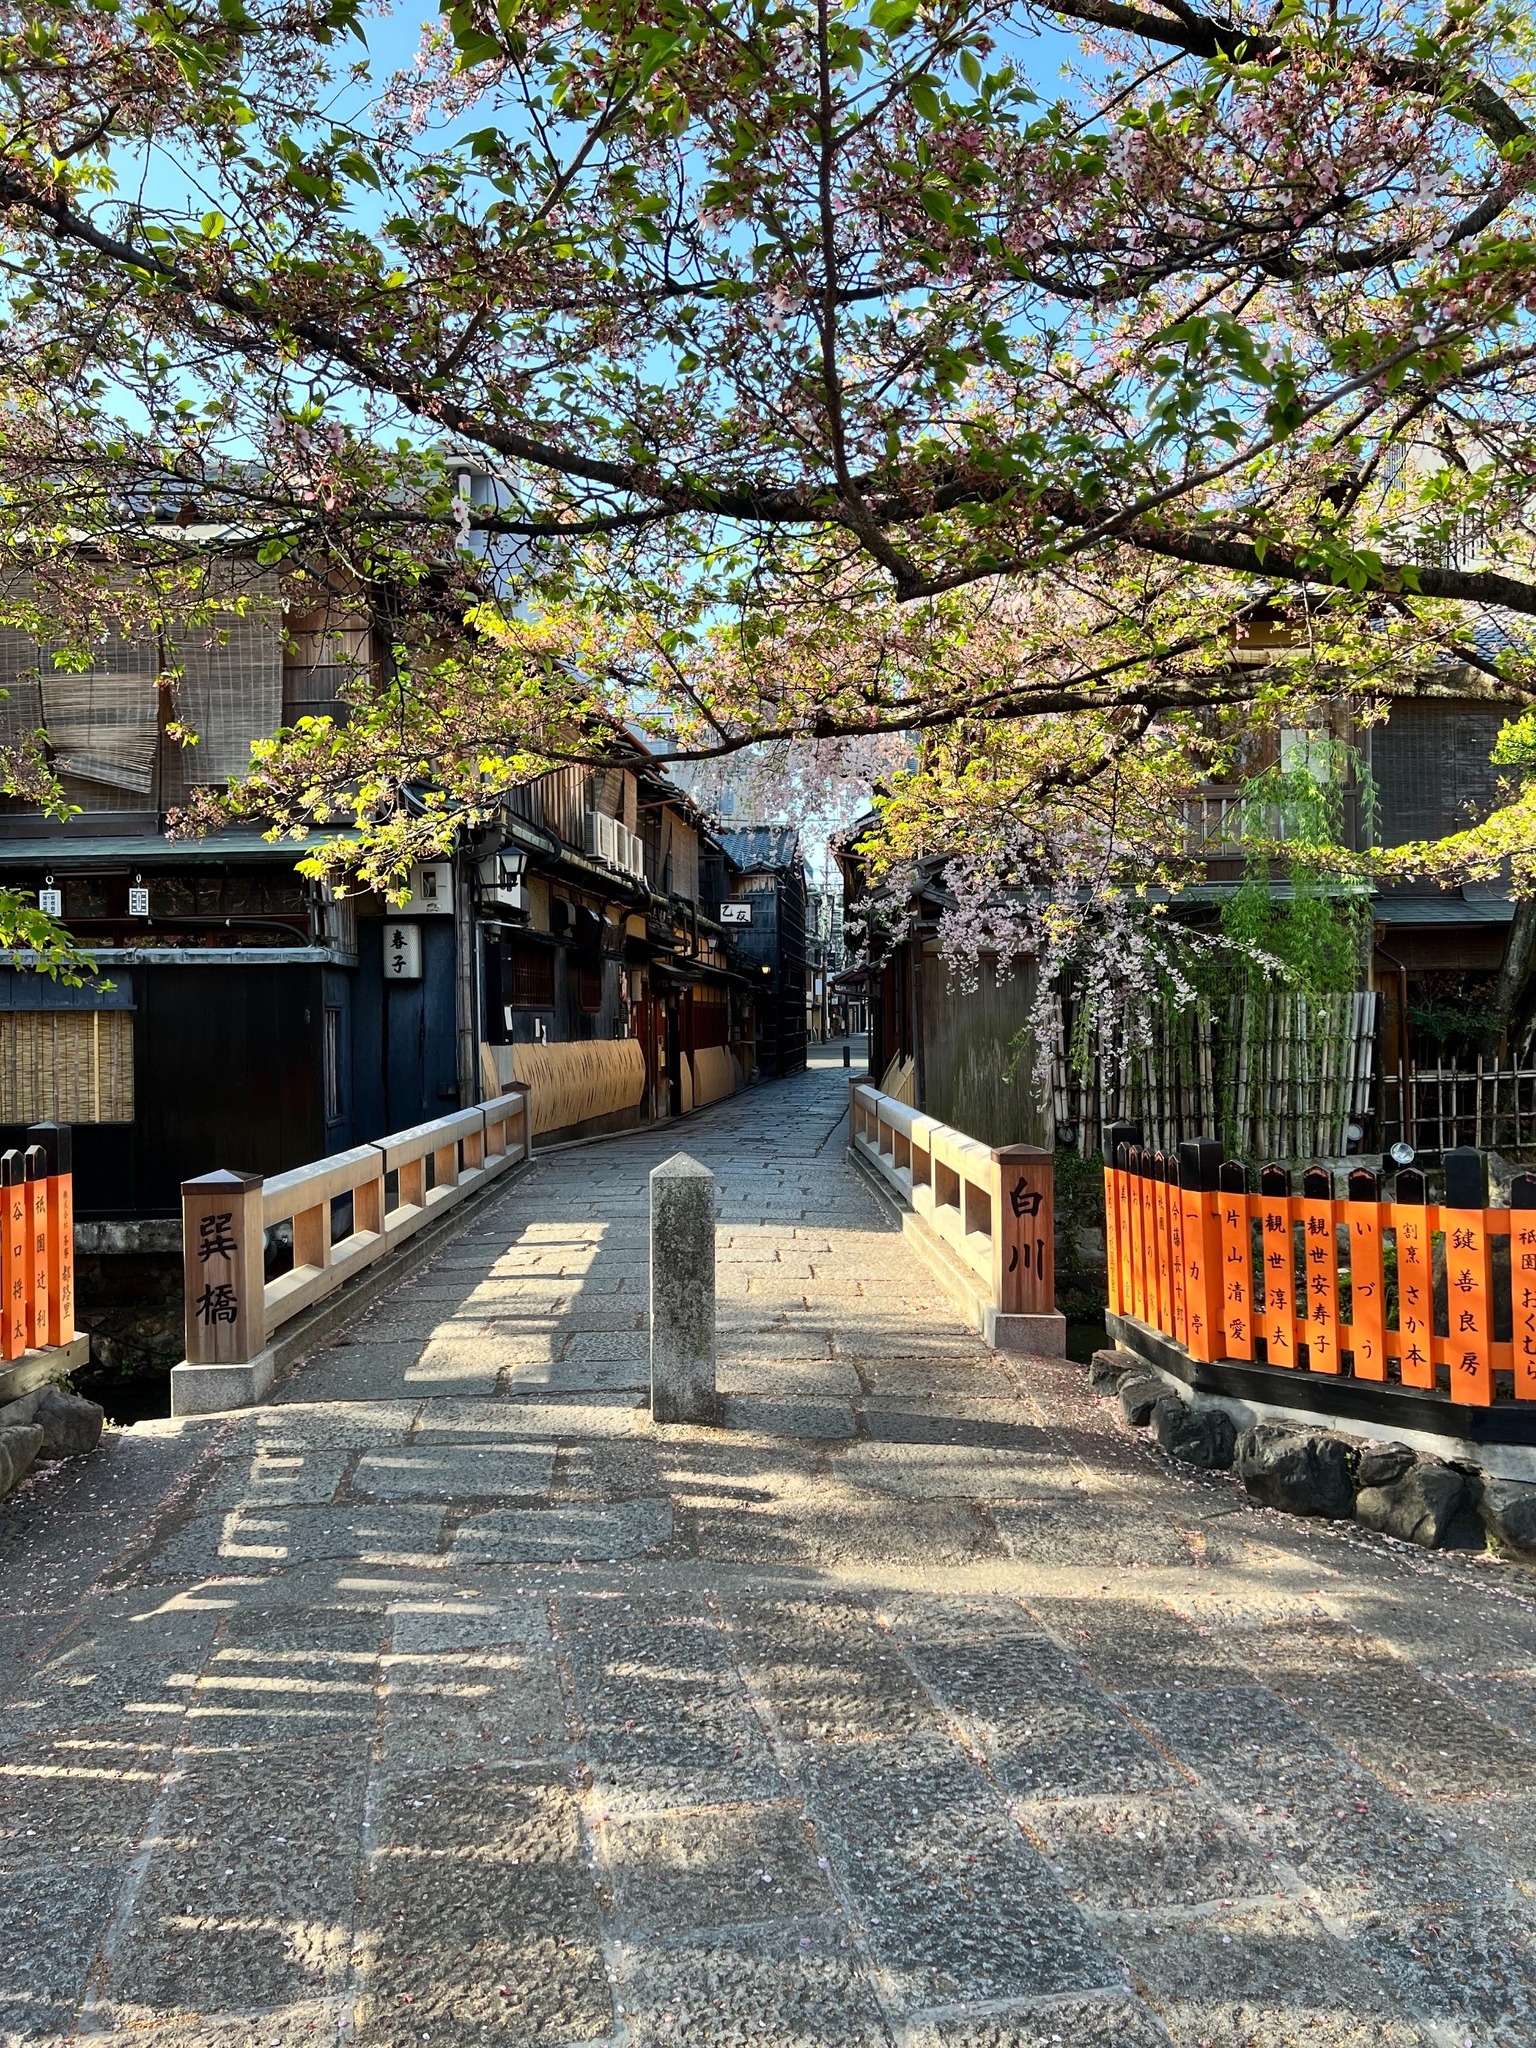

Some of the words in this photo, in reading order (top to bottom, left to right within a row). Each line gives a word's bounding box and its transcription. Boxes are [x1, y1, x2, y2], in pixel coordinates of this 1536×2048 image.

[391, 929, 408, 973] 春子
[12, 1201, 24, 1339] 谷口将太
[196, 1212, 238, 1325] 巽橋
[1008, 1177, 1045, 1281] 白川
[1186, 1213, 1203, 1335] 一力亭
[1226, 1209, 1246, 1342] 片山清愛
[1265, 1213, 1288, 1347] 観世淳夫
[1307, 1216, 1331, 1354] 観世安寿子
[1356, 1221, 1375, 1359] いづう
[1452, 1228, 1481, 1376] 鍵善良房
